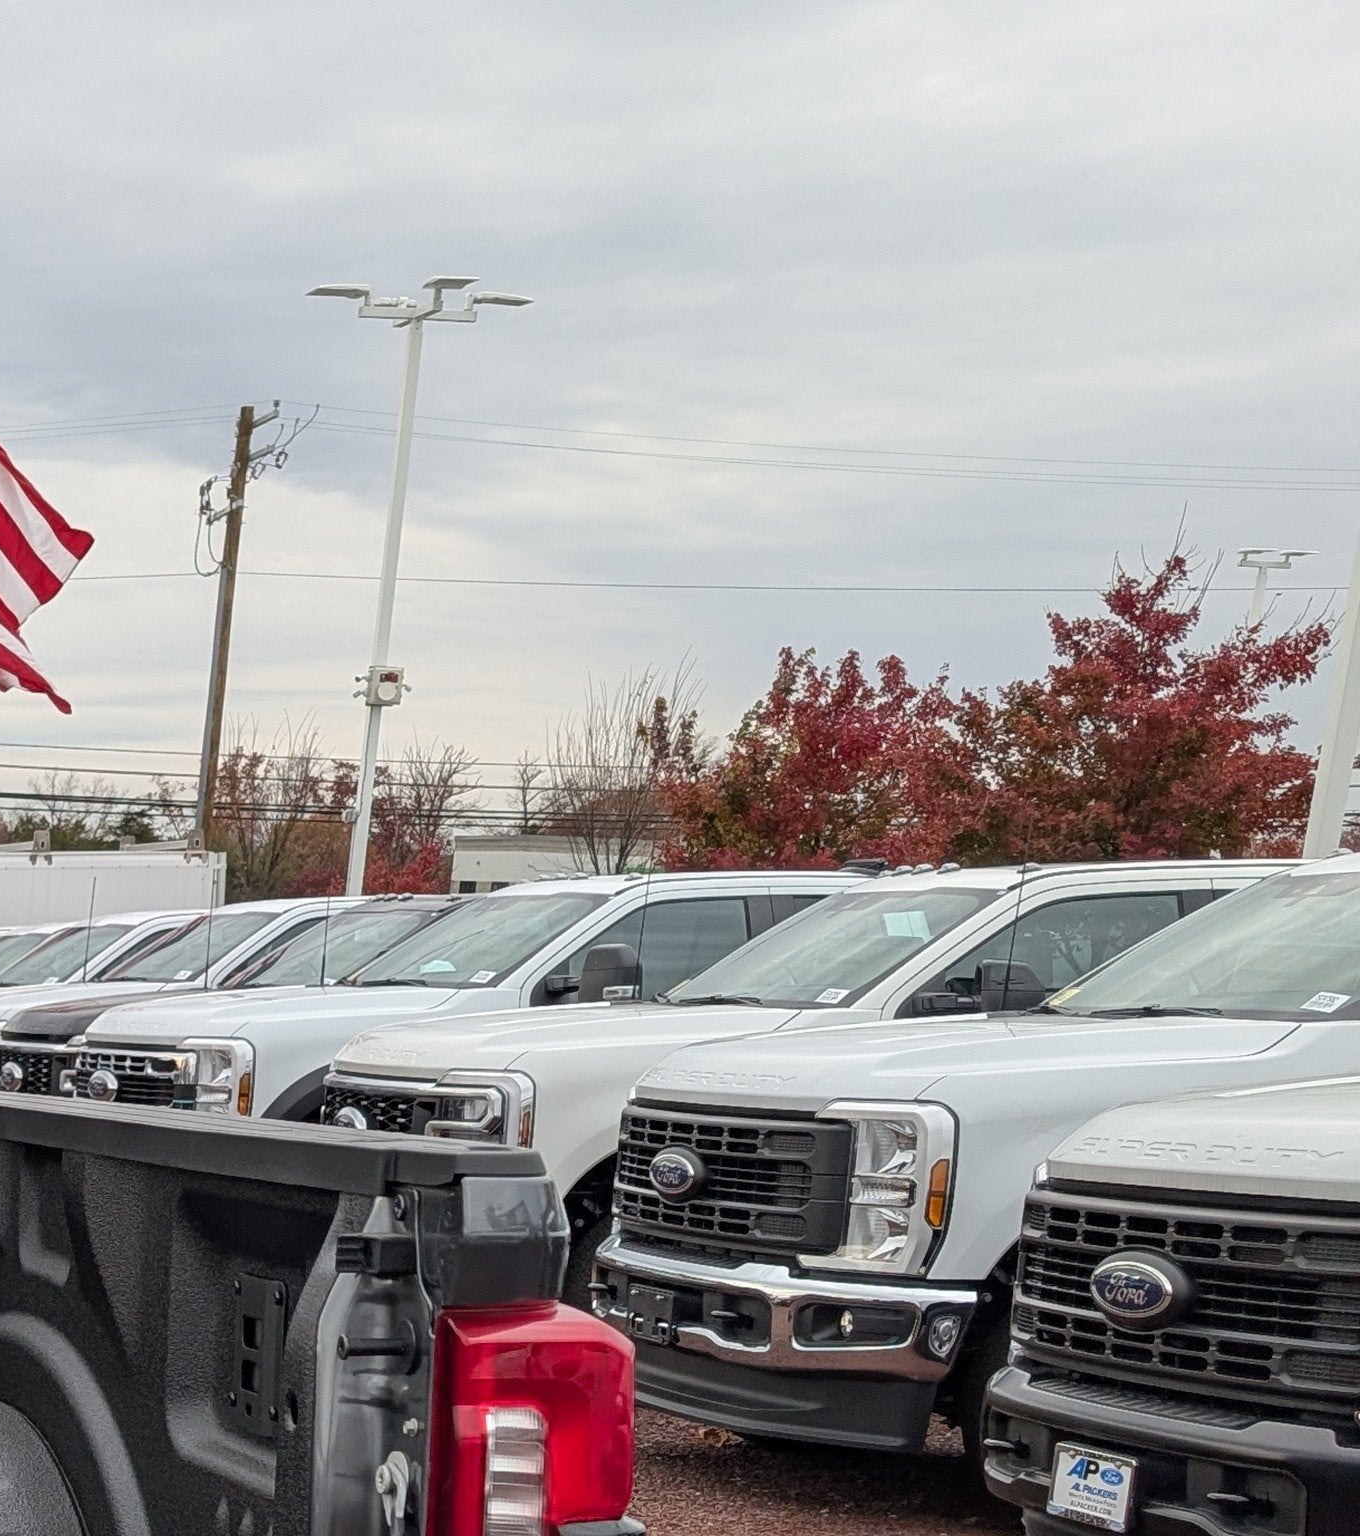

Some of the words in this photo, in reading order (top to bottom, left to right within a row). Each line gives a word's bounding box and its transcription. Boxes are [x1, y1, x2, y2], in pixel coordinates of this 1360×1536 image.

[1072, 1136, 1198, 1162] SUPER
[1198, 1143, 1345, 1170] DUTY
[1103, 1270, 1152, 1307] Ford
[1066, 1457, 1100, 1480] AP
